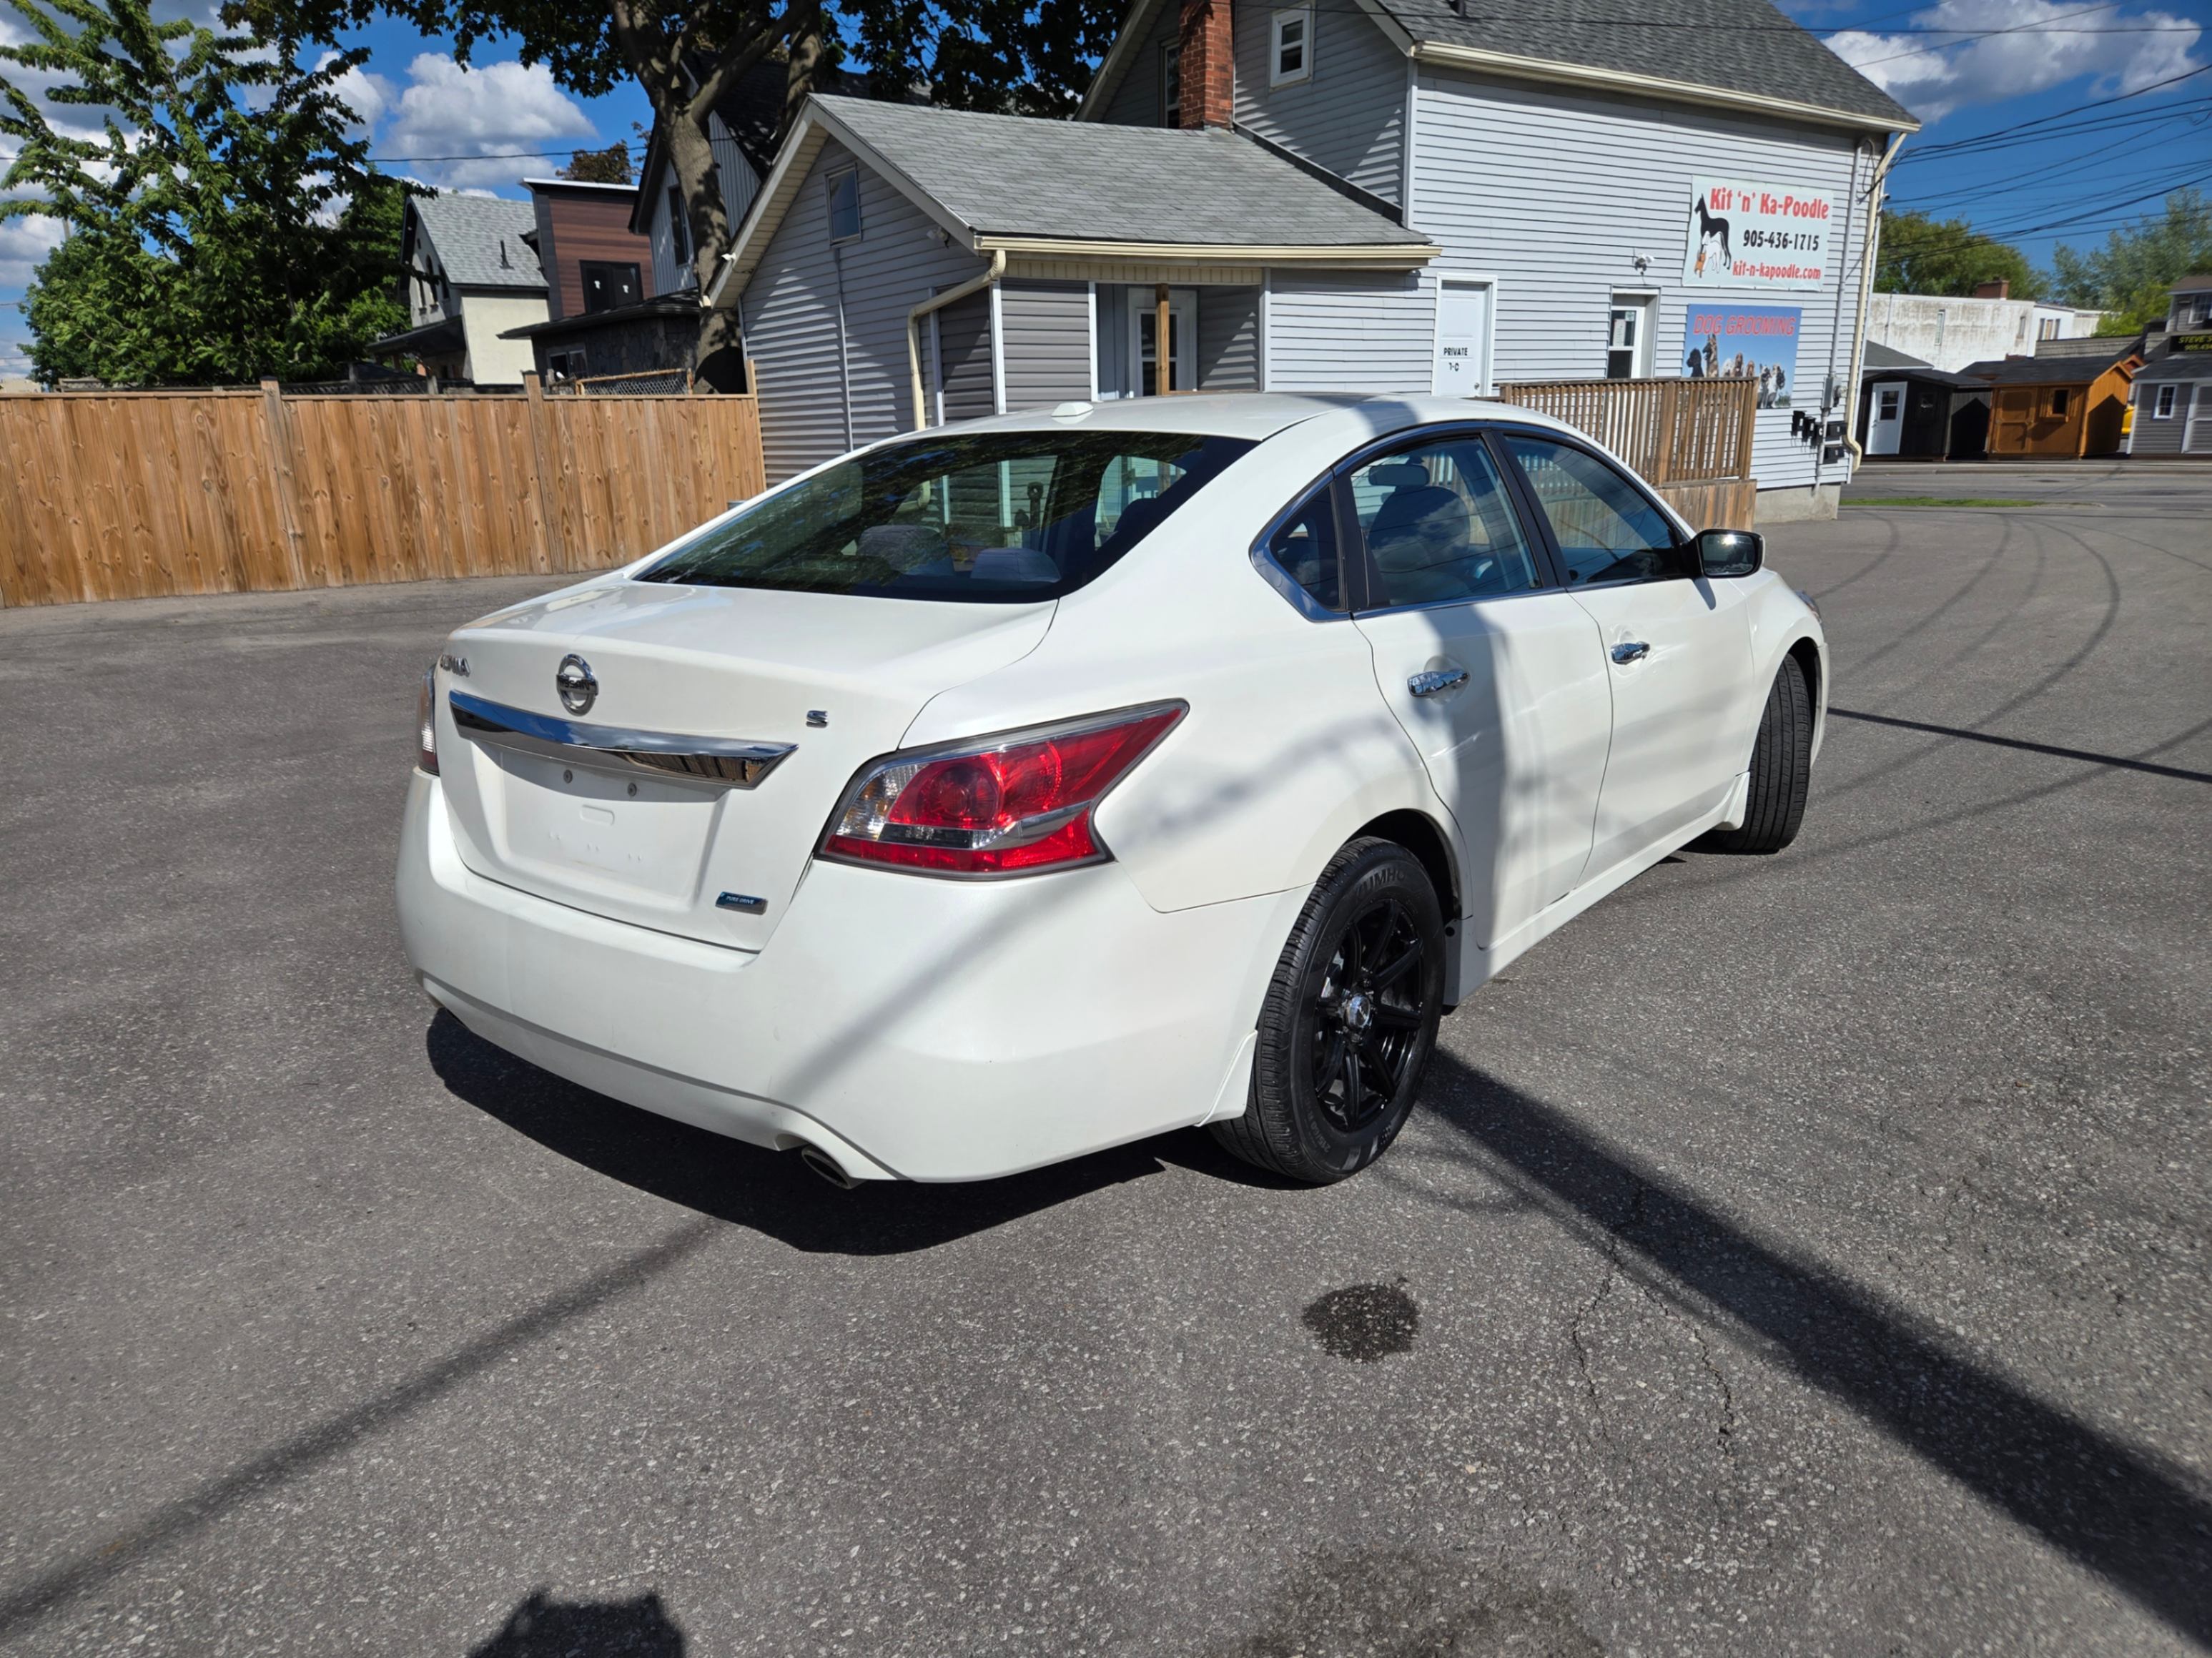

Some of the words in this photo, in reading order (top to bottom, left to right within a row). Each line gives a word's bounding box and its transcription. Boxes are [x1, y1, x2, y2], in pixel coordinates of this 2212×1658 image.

[1709, 187, 1733, 210] Kit
[1759, 192, 1830, 219] Ka-Poodle
[1742, 229, 1820, 251] 905-436-1715
[1732, 260, 1822, 280] kit-n-kapoodle.com
[1693, 314, 1724, 335] DOG
[1725, 315, 1797, 336] GROOMING
[1443, 347, 1468, 356] PRIVATE
